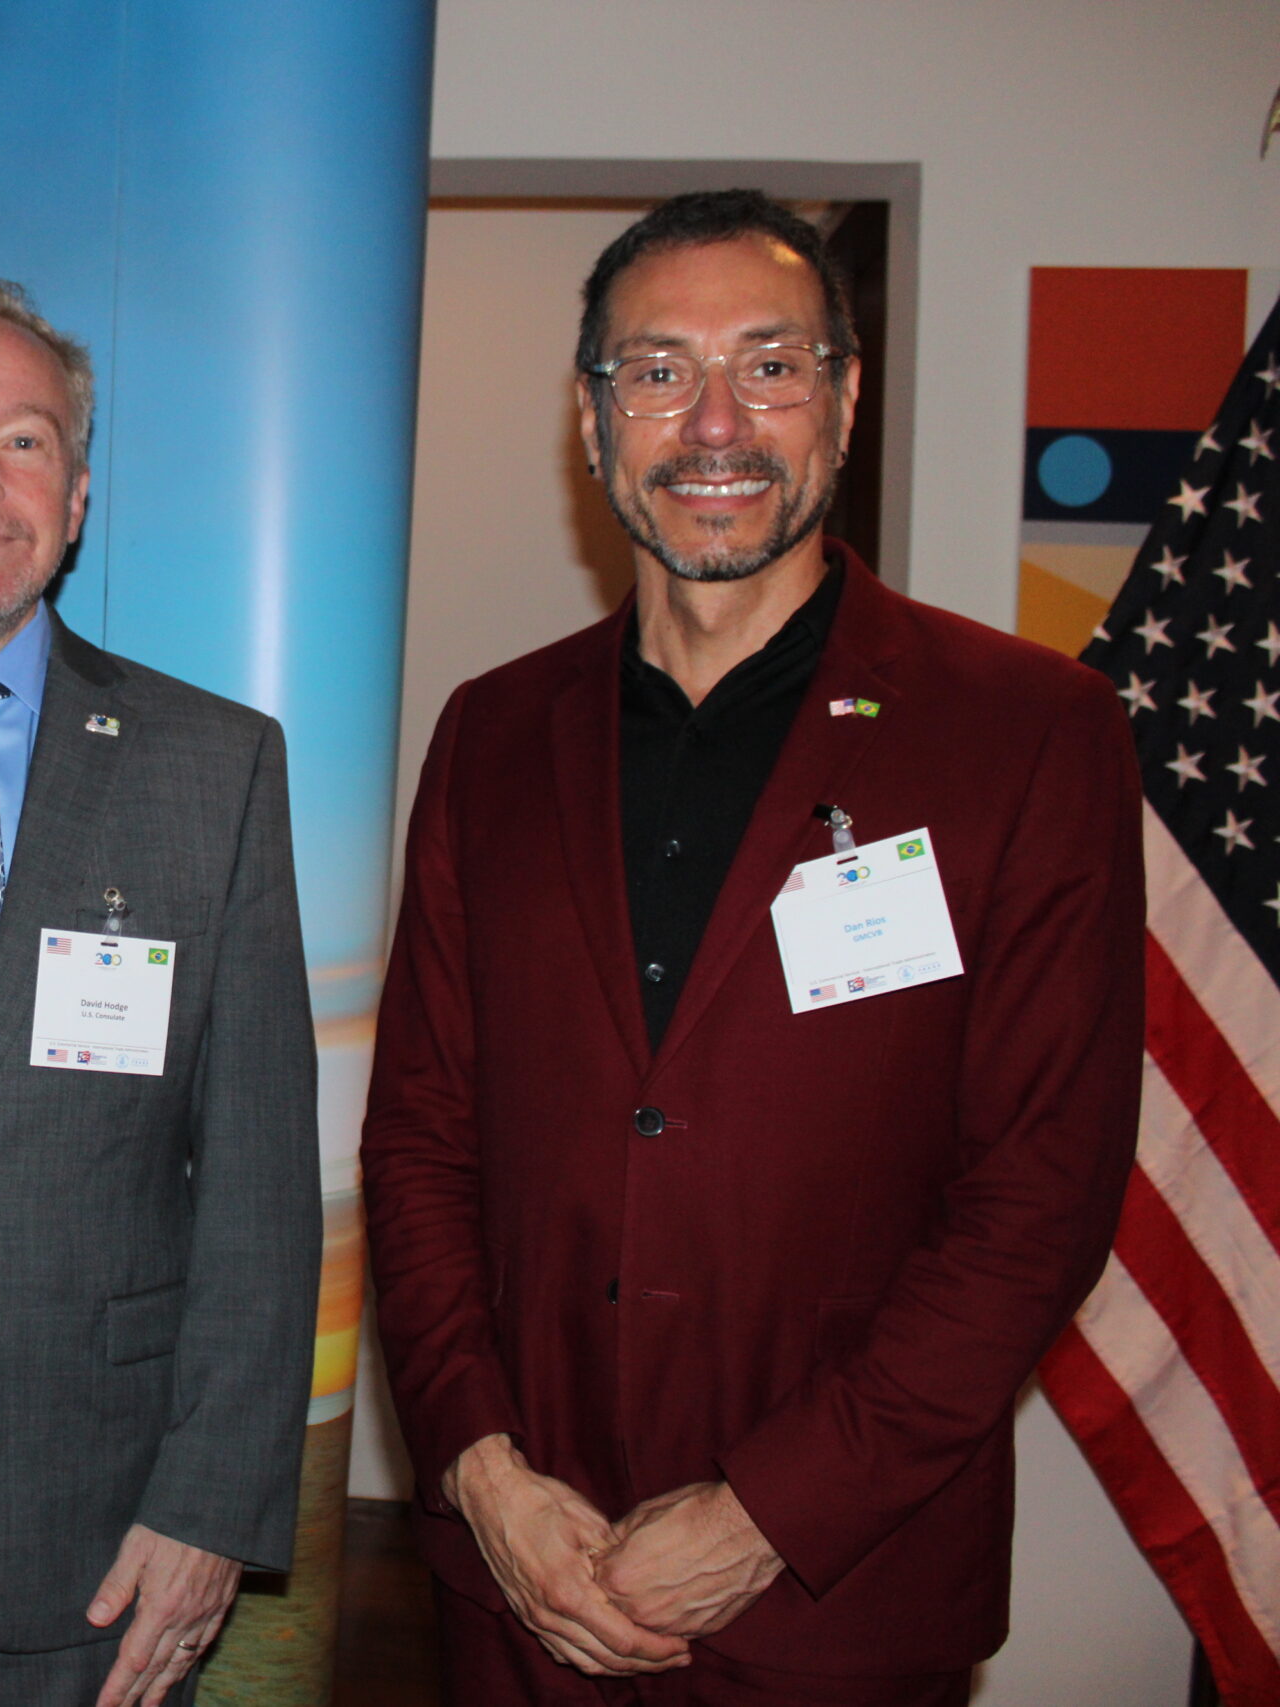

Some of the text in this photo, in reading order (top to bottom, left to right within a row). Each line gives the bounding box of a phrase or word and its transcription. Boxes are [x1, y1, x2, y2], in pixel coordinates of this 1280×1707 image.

[844, 917, 886, 933] Dan Rios
[80, 999, 128, 1012] David Hodge
[95, 1012, 125, 1020] Consulate
